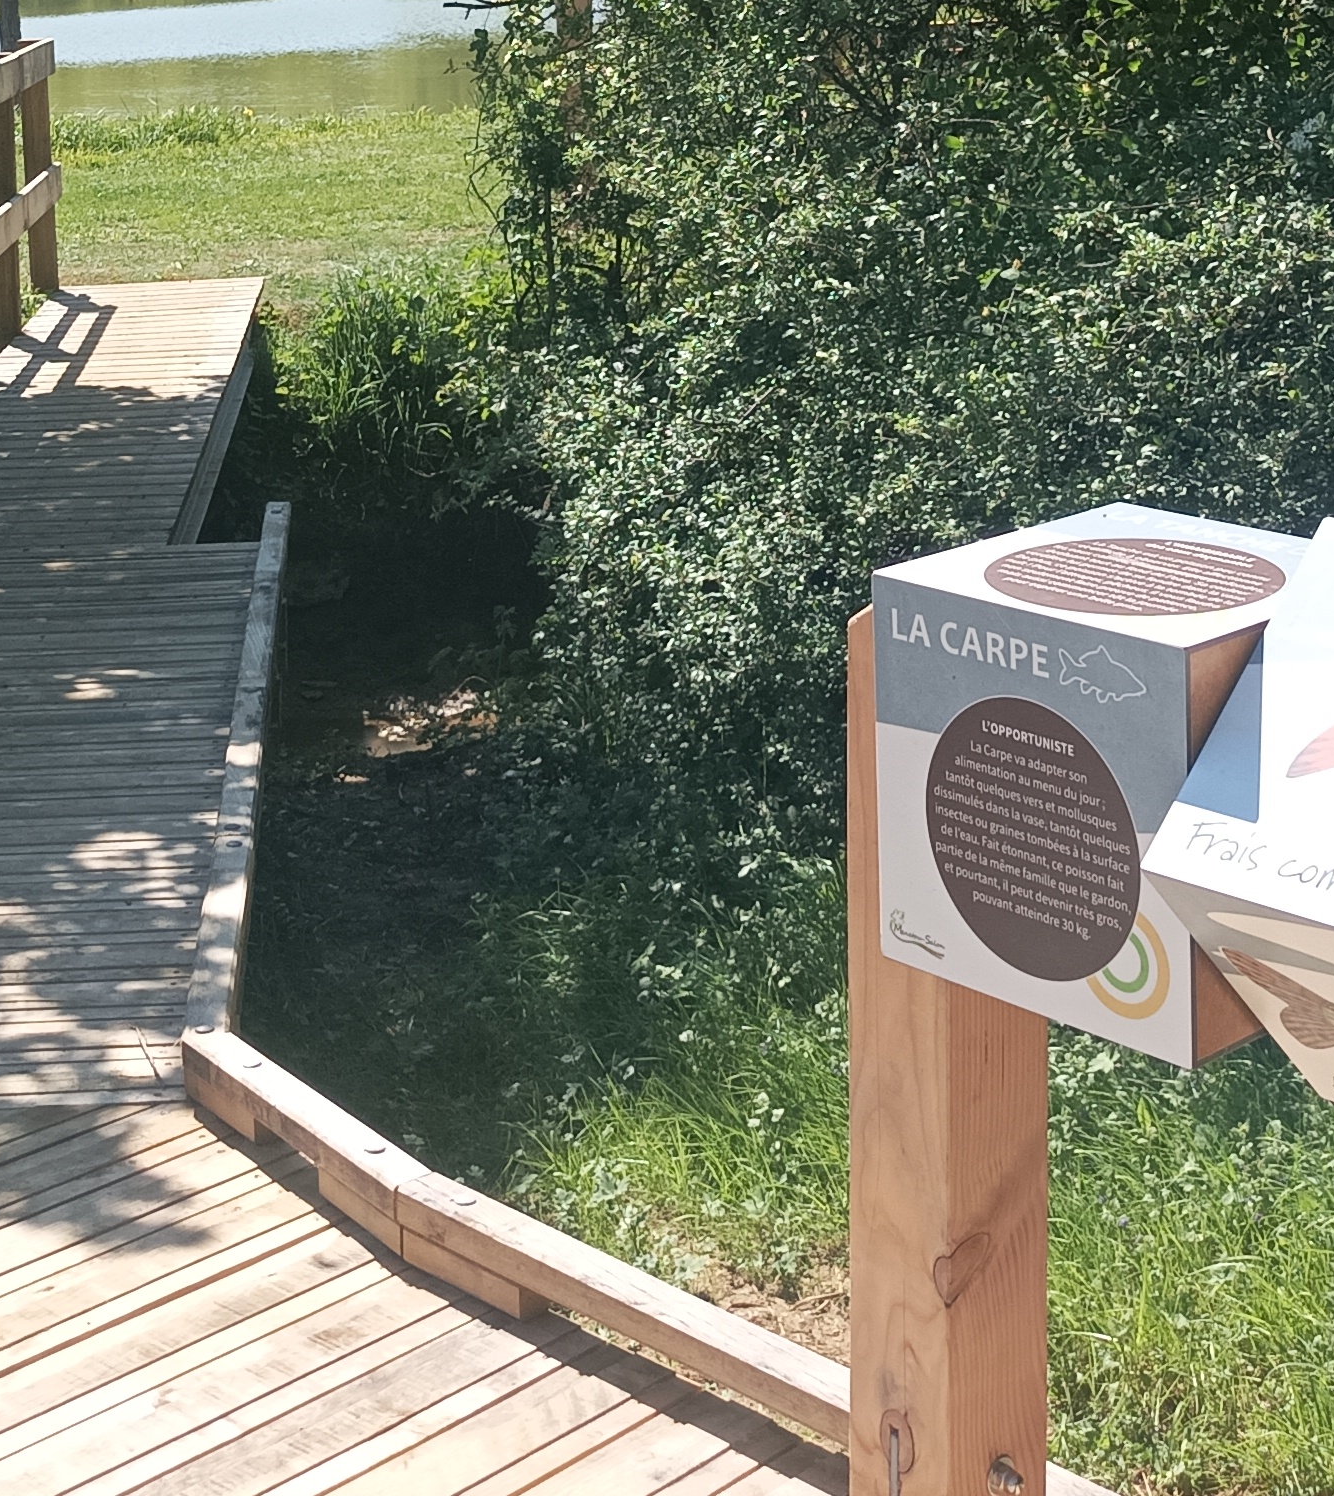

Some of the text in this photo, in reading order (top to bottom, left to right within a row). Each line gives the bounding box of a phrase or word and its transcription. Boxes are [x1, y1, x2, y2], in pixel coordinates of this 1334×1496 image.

[890, 607, 1050, 680] LA CARPE
[969, 739, 1088, 786] La Carpe va adapter son
[981, 719, 1075, 758] L'OPPORTUNISTE
[944, 769, 1118, 833] tantôt quelques vers et mollusques
[954, 754, 1017, 783] alimentation
[1017, 774, 1032, 787] au
[1032, 778, 1063, 797] menu
[1063, 785, 1078, 801] du
[1078, 789, 1102, 808] jour
[933, 783, 1131, 856] dissimulés dans la vase, tantôt quelques
[934, 804, 975, 826] insectes
[974, 816, 989, 830] ou
[989, 821, 1026, 842] graines
[1026, 831, 1072, 856] tombées
[1080, 846, 1092, 863] la
[1091, 853, 1131, 876] surface
[1185, 821, 1268, 871] Frais
[934, 840, 1132, 917] partie de la même famille que le gardon,
[940, 822, 1125, 893] de l'eau. Fait étonnant, ce poisson fait
[943, 862, 1123, 933] et pourtant, il peut devenir très gros,
[972, 889, 1092, 942] pouvant atteindre 30 kg.
